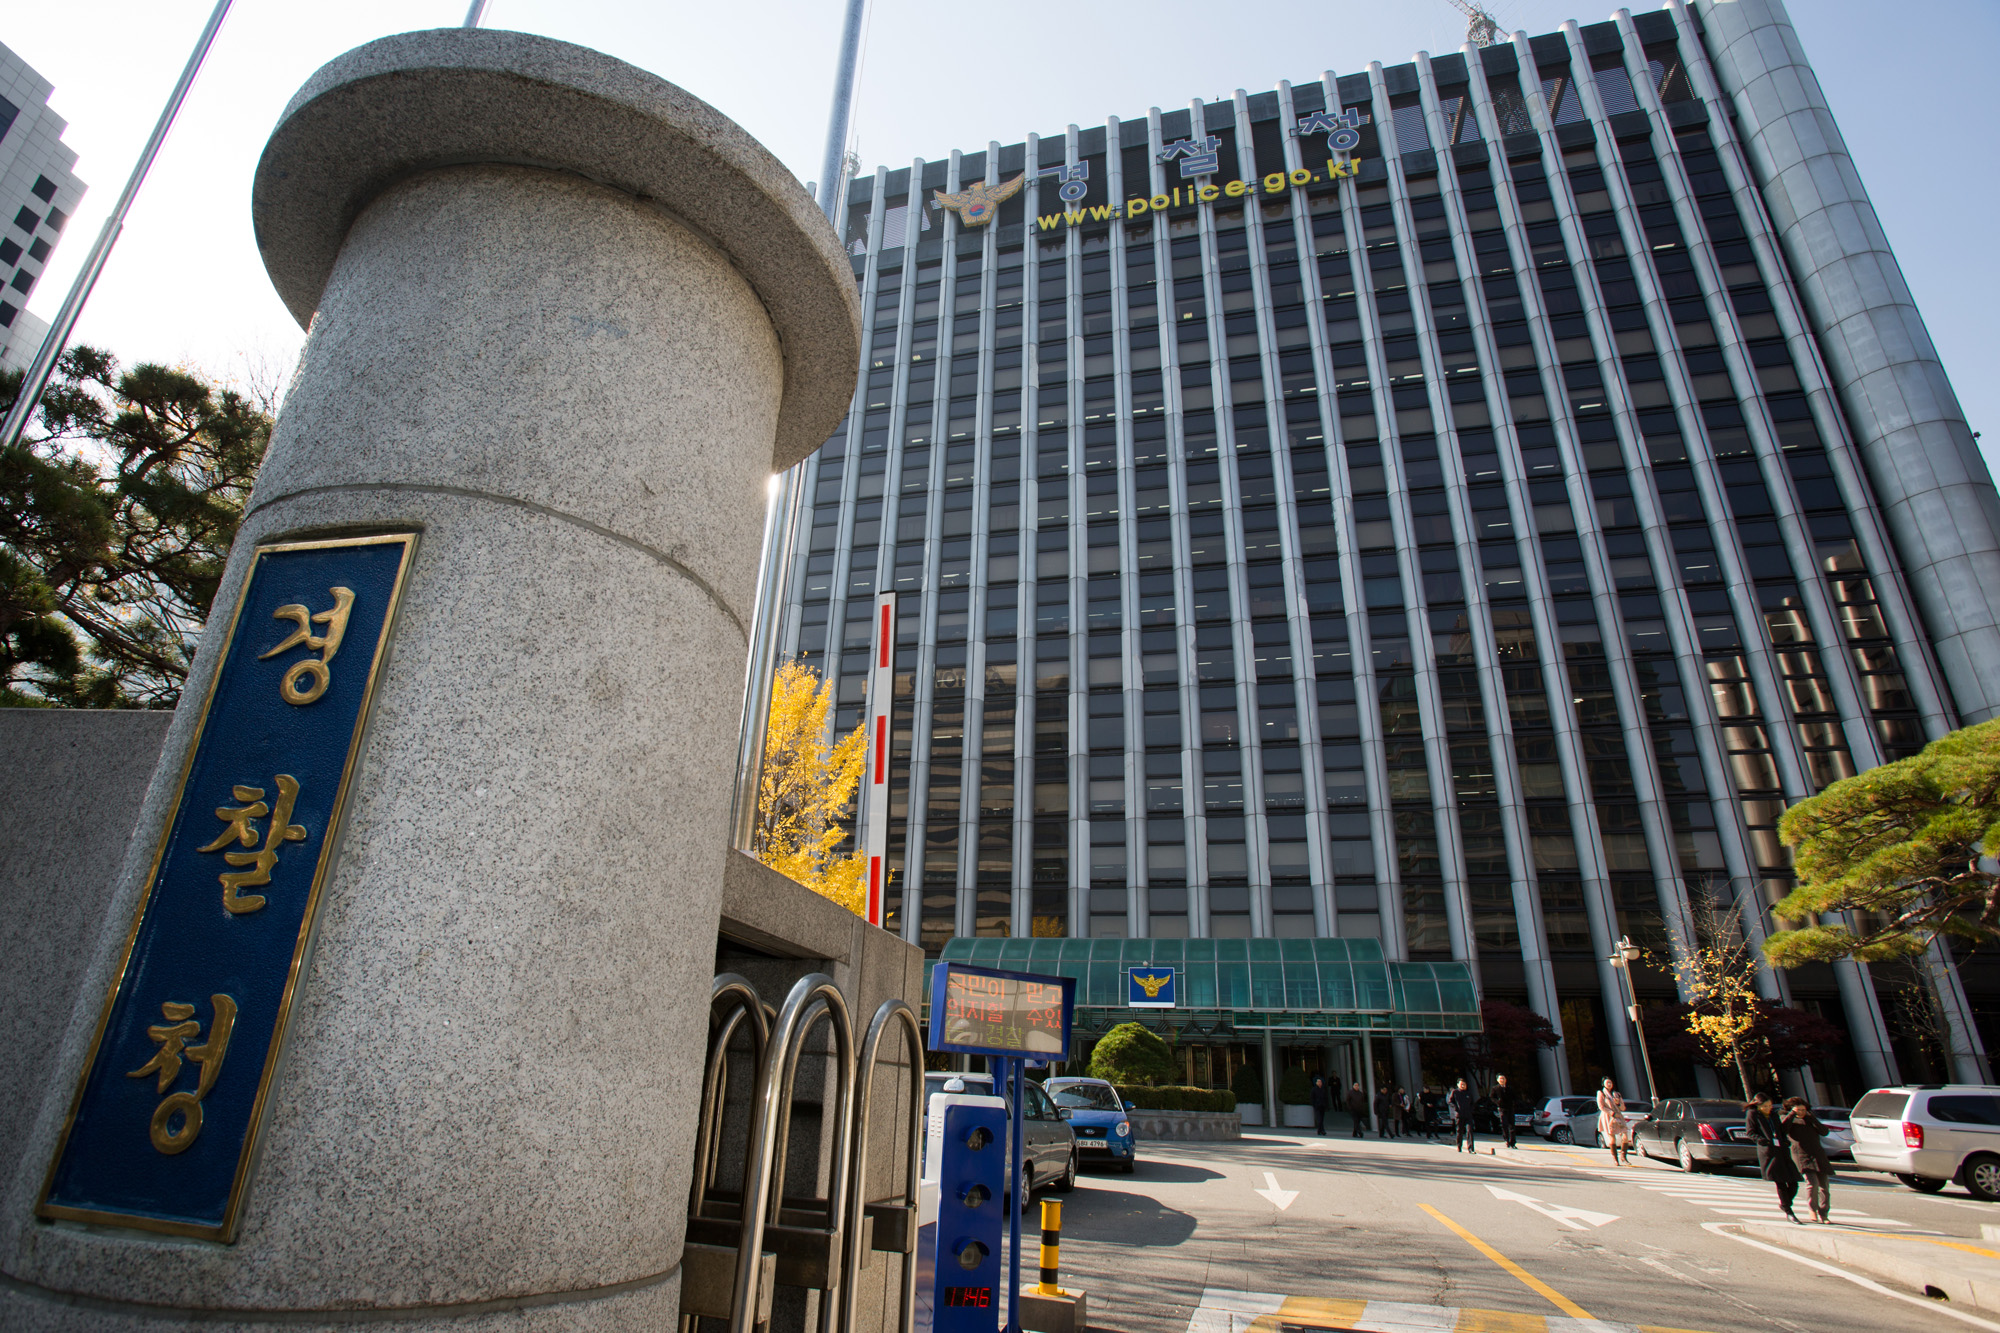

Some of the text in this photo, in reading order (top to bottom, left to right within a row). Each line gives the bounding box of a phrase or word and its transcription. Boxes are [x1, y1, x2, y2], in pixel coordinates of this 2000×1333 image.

[1037, 107, 1359, 203] 경찰청
[1037, 157, 1361, 231] www.police.go.kr
[126, 586, 355, 1155] 경찰청
[947, 998, 1006, 1022] 의지할
[948, 973, 1062, 1004] 국민이 믿고
[986, 1024, 1024, 1047] 경찰
